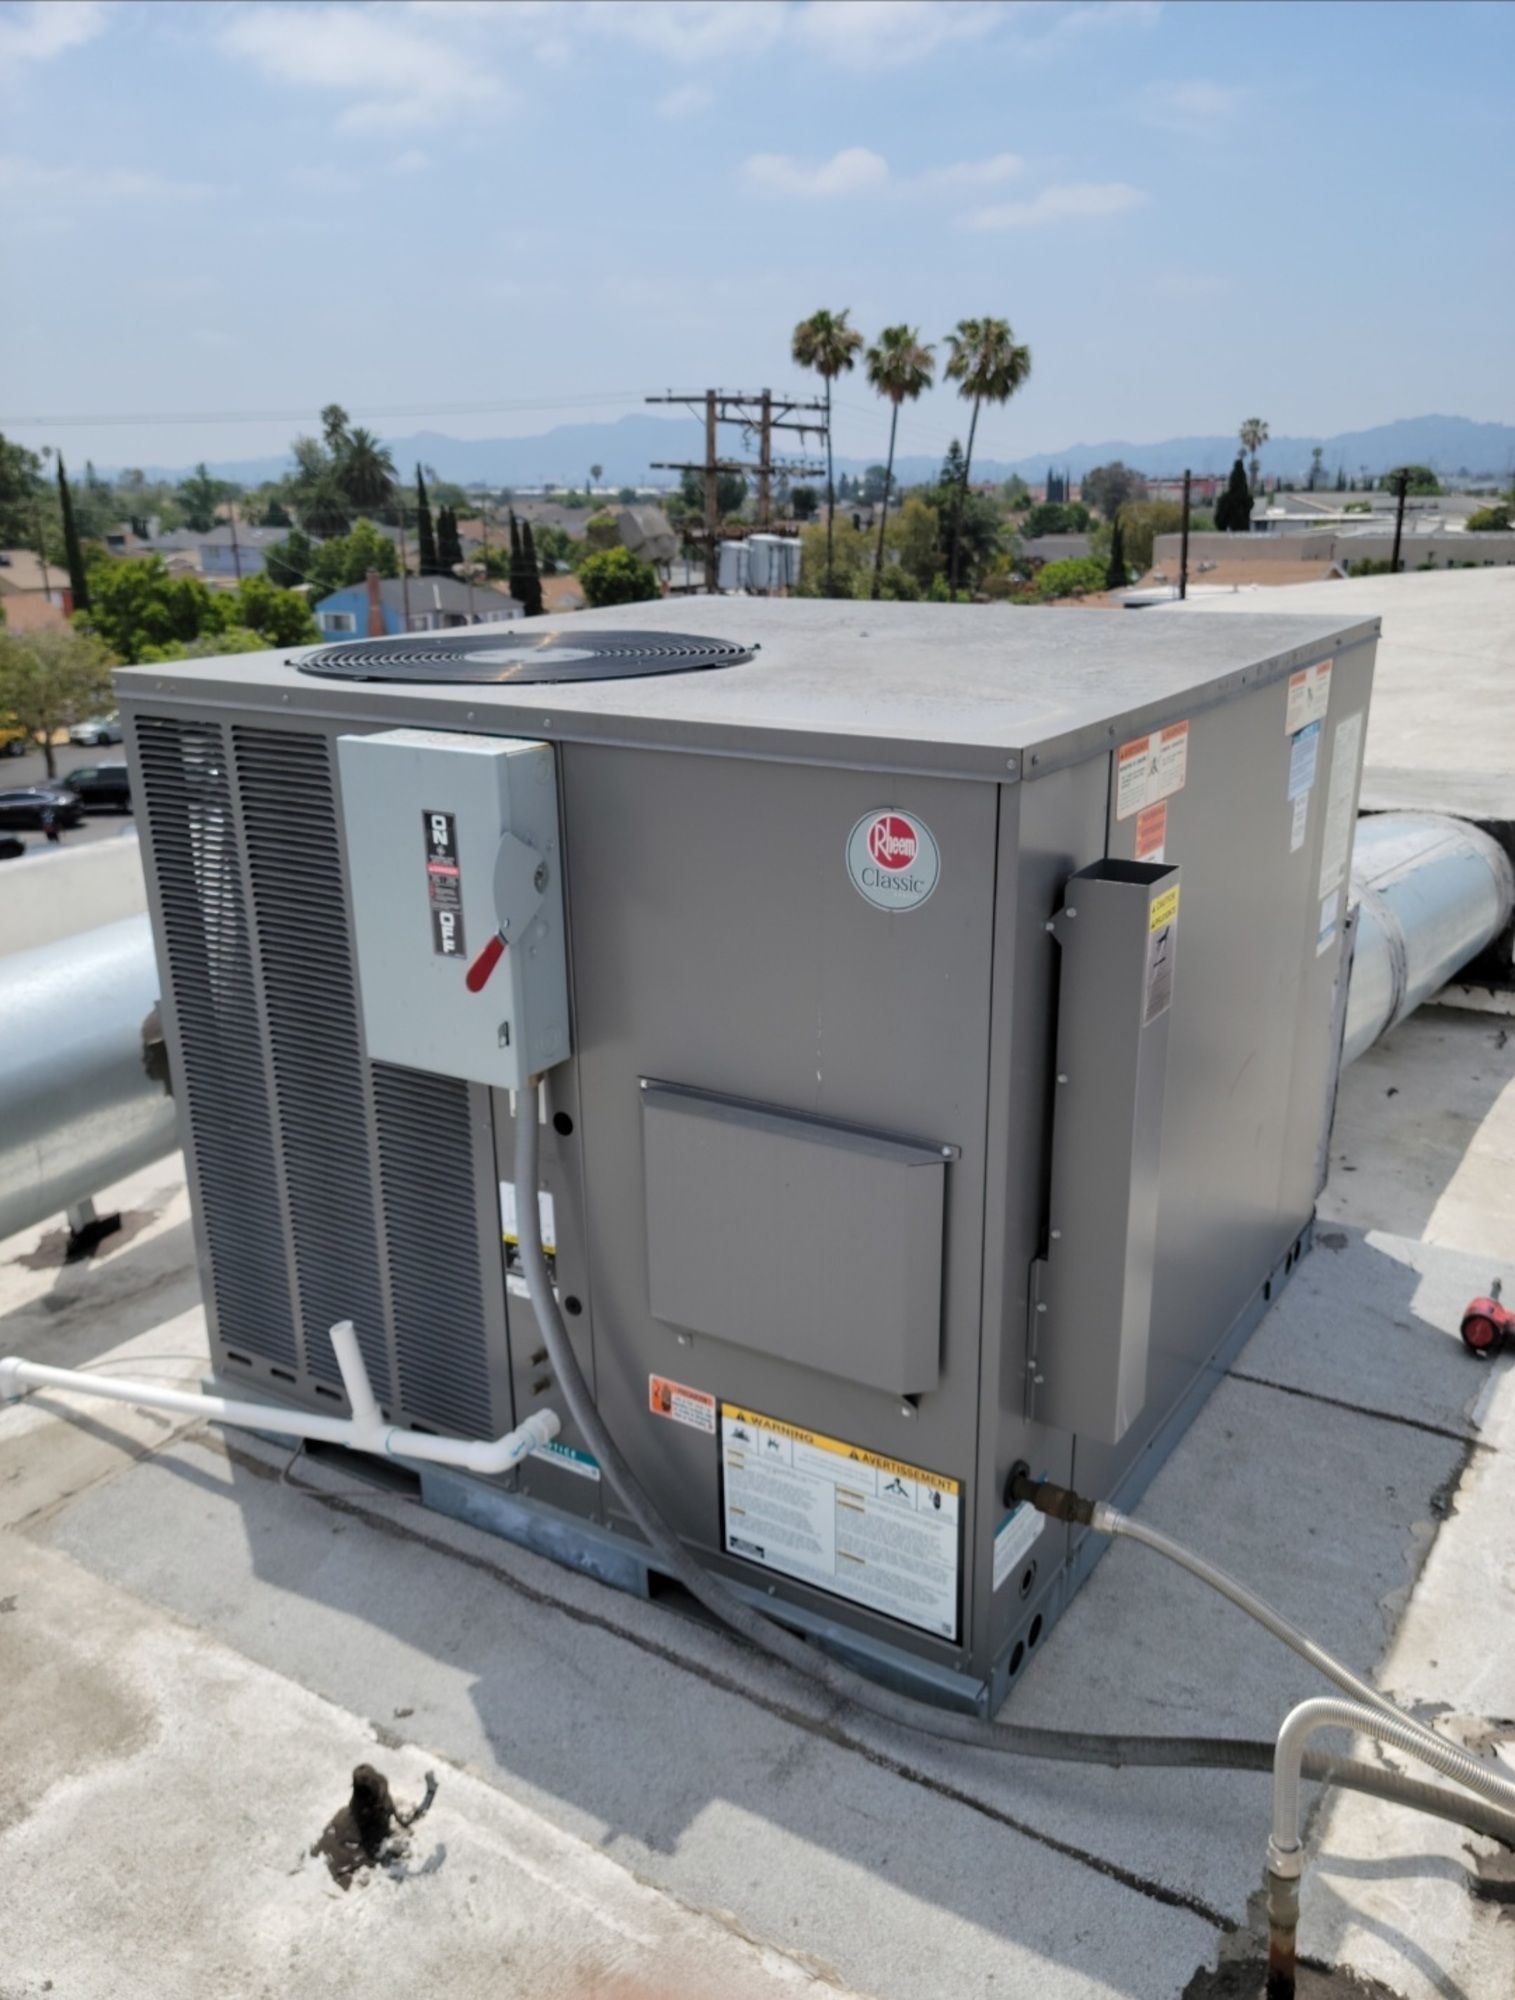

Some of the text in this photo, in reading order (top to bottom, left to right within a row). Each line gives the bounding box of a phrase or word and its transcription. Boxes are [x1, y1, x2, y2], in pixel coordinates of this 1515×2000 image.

[431, 814, 448, 846] ON
[874, 816, 915, 862] Rheem
[861, 867, 924, 894] Classic
[439, 911, 457, 953] OFF
[750, 1413, 814, 1445] WARNING
[862, 1452, 953, 1491] AVERTISSEMENT
